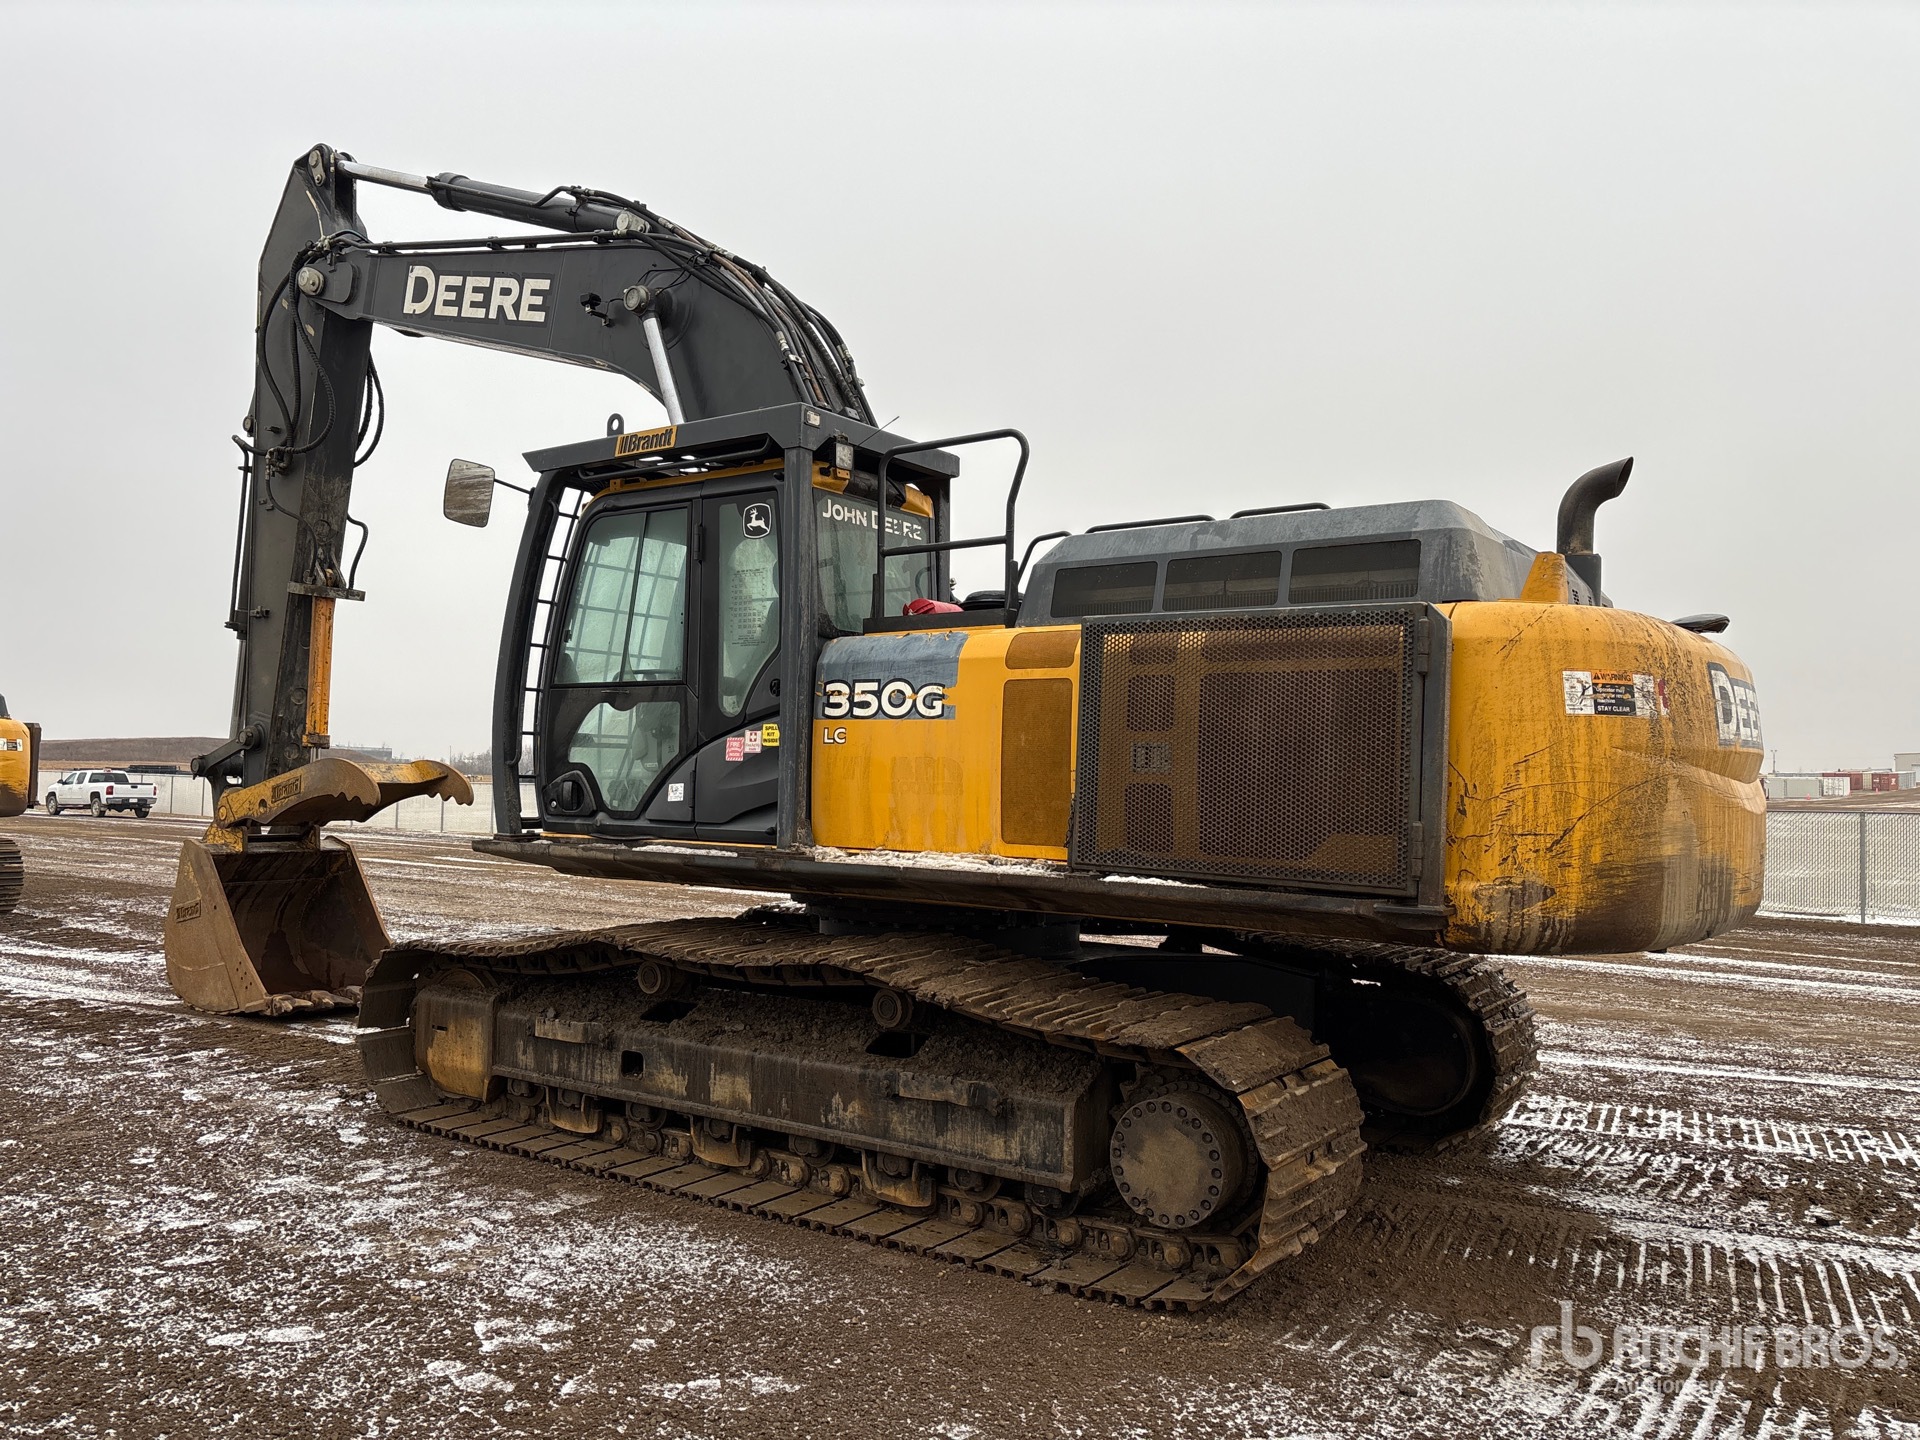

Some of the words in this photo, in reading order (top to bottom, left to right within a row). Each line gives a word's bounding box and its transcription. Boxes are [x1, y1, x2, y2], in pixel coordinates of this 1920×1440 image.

[403, 265, 551, 323] DEERE
[626, 428, 674, 452] Brandt
[822, 498, 868, 527] JOHN
[822, 678, 945, 719] 350G
[1710, 669, 1762, 743] DEE
[823, 727, 847, 744] LC
